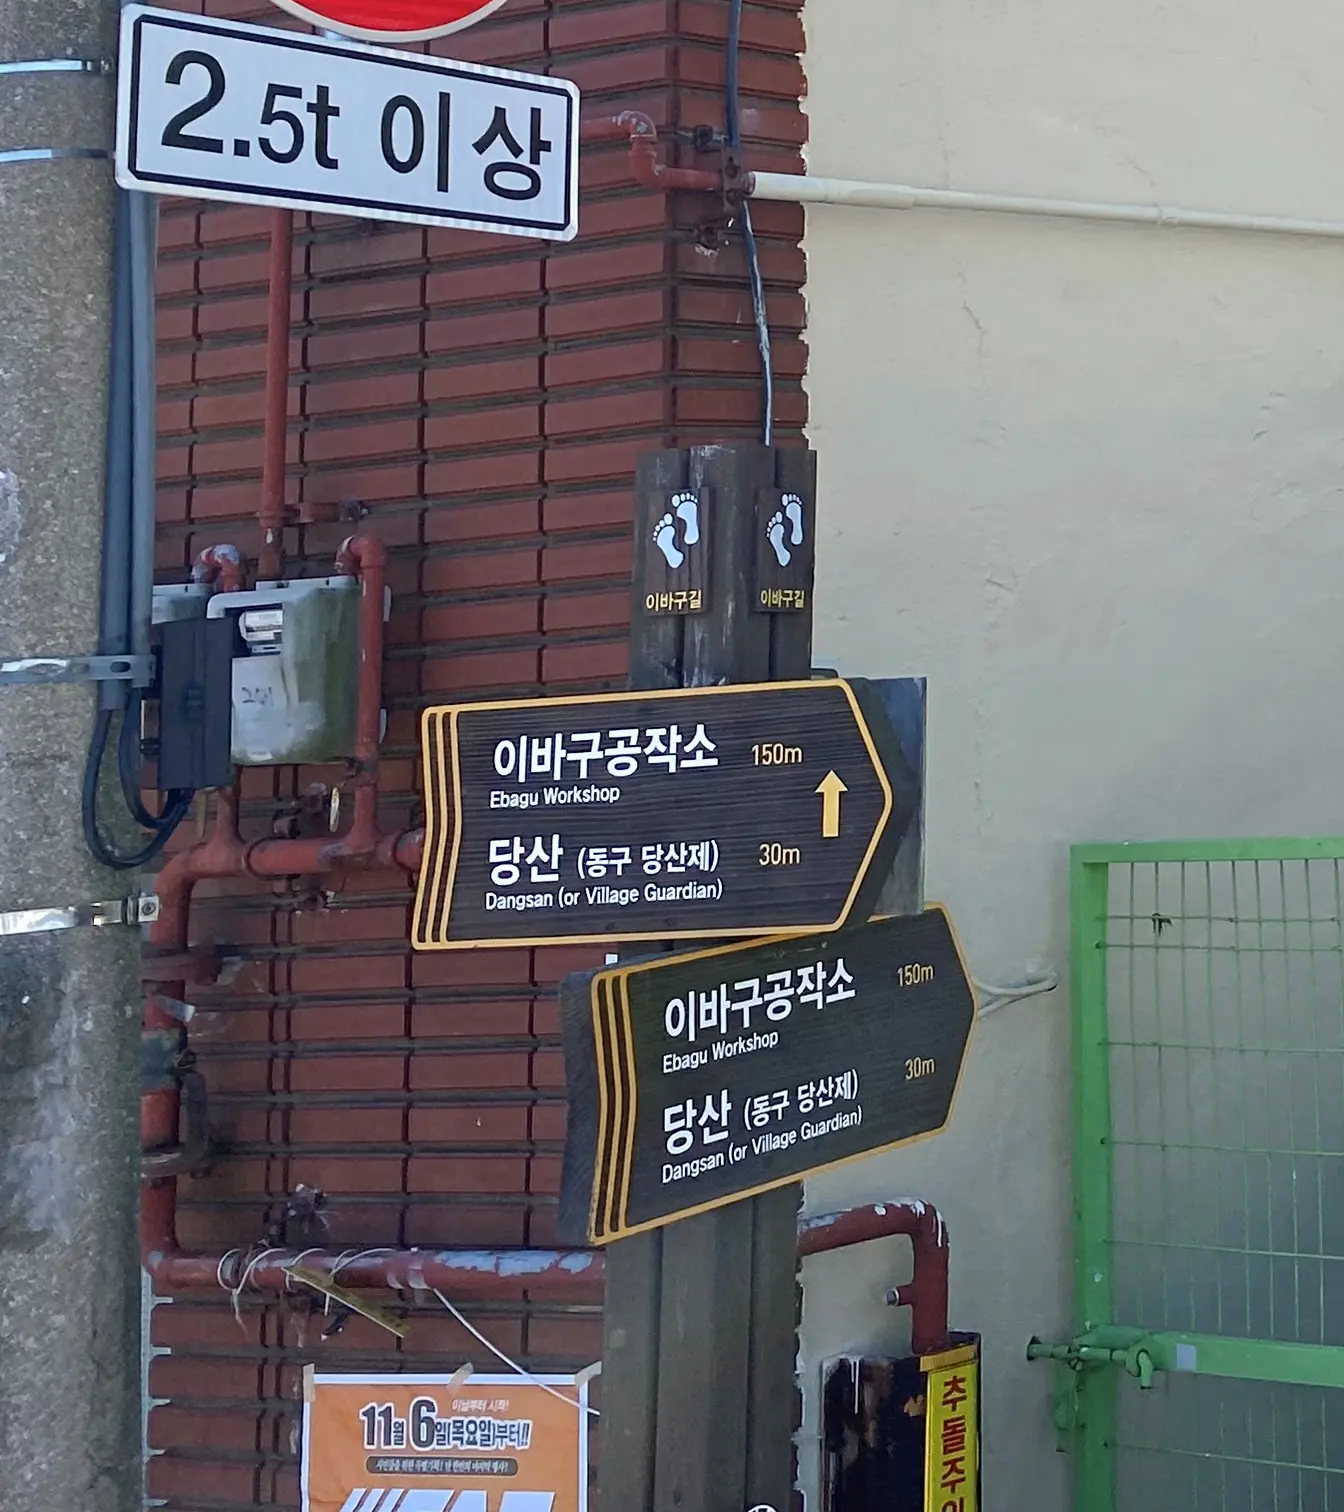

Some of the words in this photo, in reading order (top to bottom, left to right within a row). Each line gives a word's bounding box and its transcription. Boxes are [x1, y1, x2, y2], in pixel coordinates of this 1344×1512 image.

[160, 49, 341, 170] 2.5t
[379, 90, 552, 201] 이상
[645, 589, 703, 612] 이바구길
[760, 588, 805, 608] 이바구길
[493, 723, 719, 783] 이바구공작소
[750, 742, 803, 767] 150m
[488, 788, 539, 810] Ebagu
[543, 783, 621, 806] Workshop
[487, 833, 564, 887] 당산
[576, 846, 633, 880] (동구
[640, 839, 720, 876] 당산제)
[758, 842, 801, 867] 30m
[485, 890, 554, 912] Dangsan
[557, 885, 582, 909] (or
[585, 883, 640, 906] Village
[643, 877, 723, 902] Guardian)
[664, 957, 857, 1042] 이바구공작소
[896, 962, 935, 988] 150m
[662, 1050, 709, 1075] Ebagu
[711, 1029, 780, 1062] Workshop
[663, 1088, 733, 1156] 당산
[743, 1089, 790, 1131] (동구
[796, 1068, 860, 1114] 당산제)
[904, 1056, 936, 1082] 30m
[661, 1151, 725, 1185] Dangsan
[728, 1142, 748, 1166] (or
[751, 1128, 798, 1156] Village
[800, 1103, 863, 1141] Guardian)
